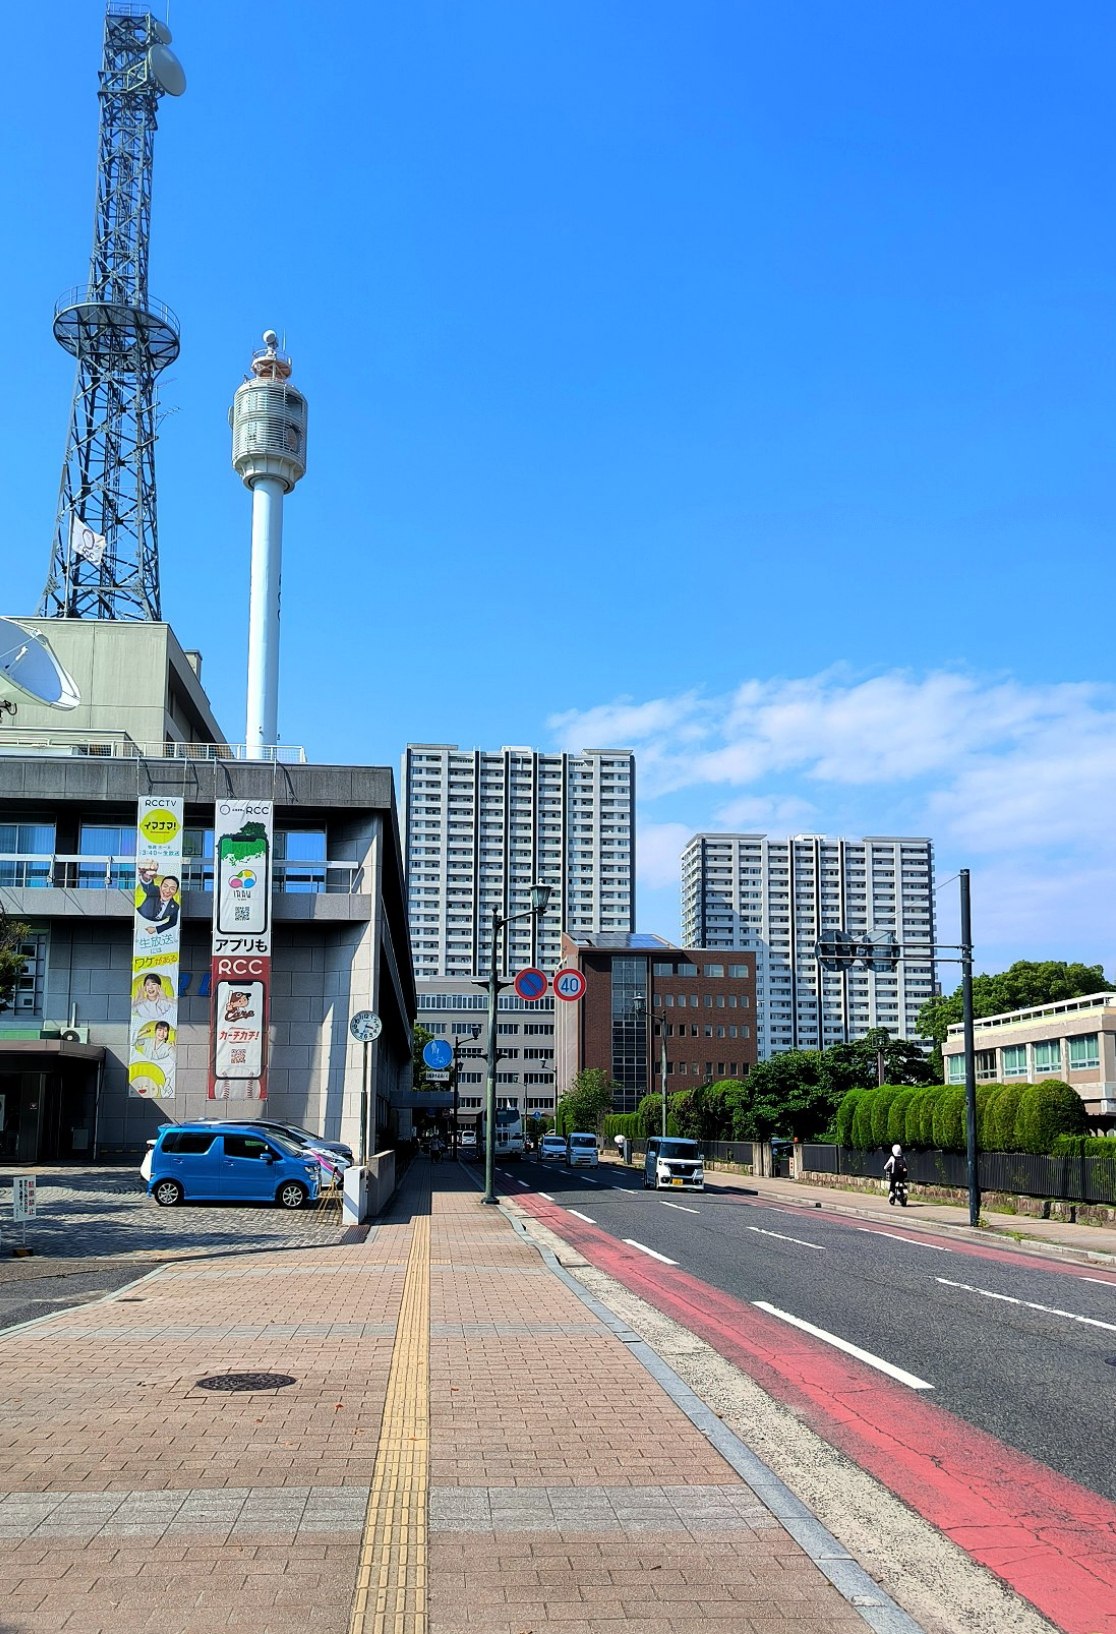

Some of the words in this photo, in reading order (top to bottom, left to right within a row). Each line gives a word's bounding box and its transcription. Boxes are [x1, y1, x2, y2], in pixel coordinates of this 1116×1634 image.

[145, 799, 177, 807] RCCTV
[245, 806, 270, 815] RCC
[215, 938, 268, 953] アプリも
[218, 958, 263, 975] RCC
[560, 977, 579, 992] 40
[224, 1009, 256, 1022] Carp
[219, 1030, 260, 1041] カーチカチ!
